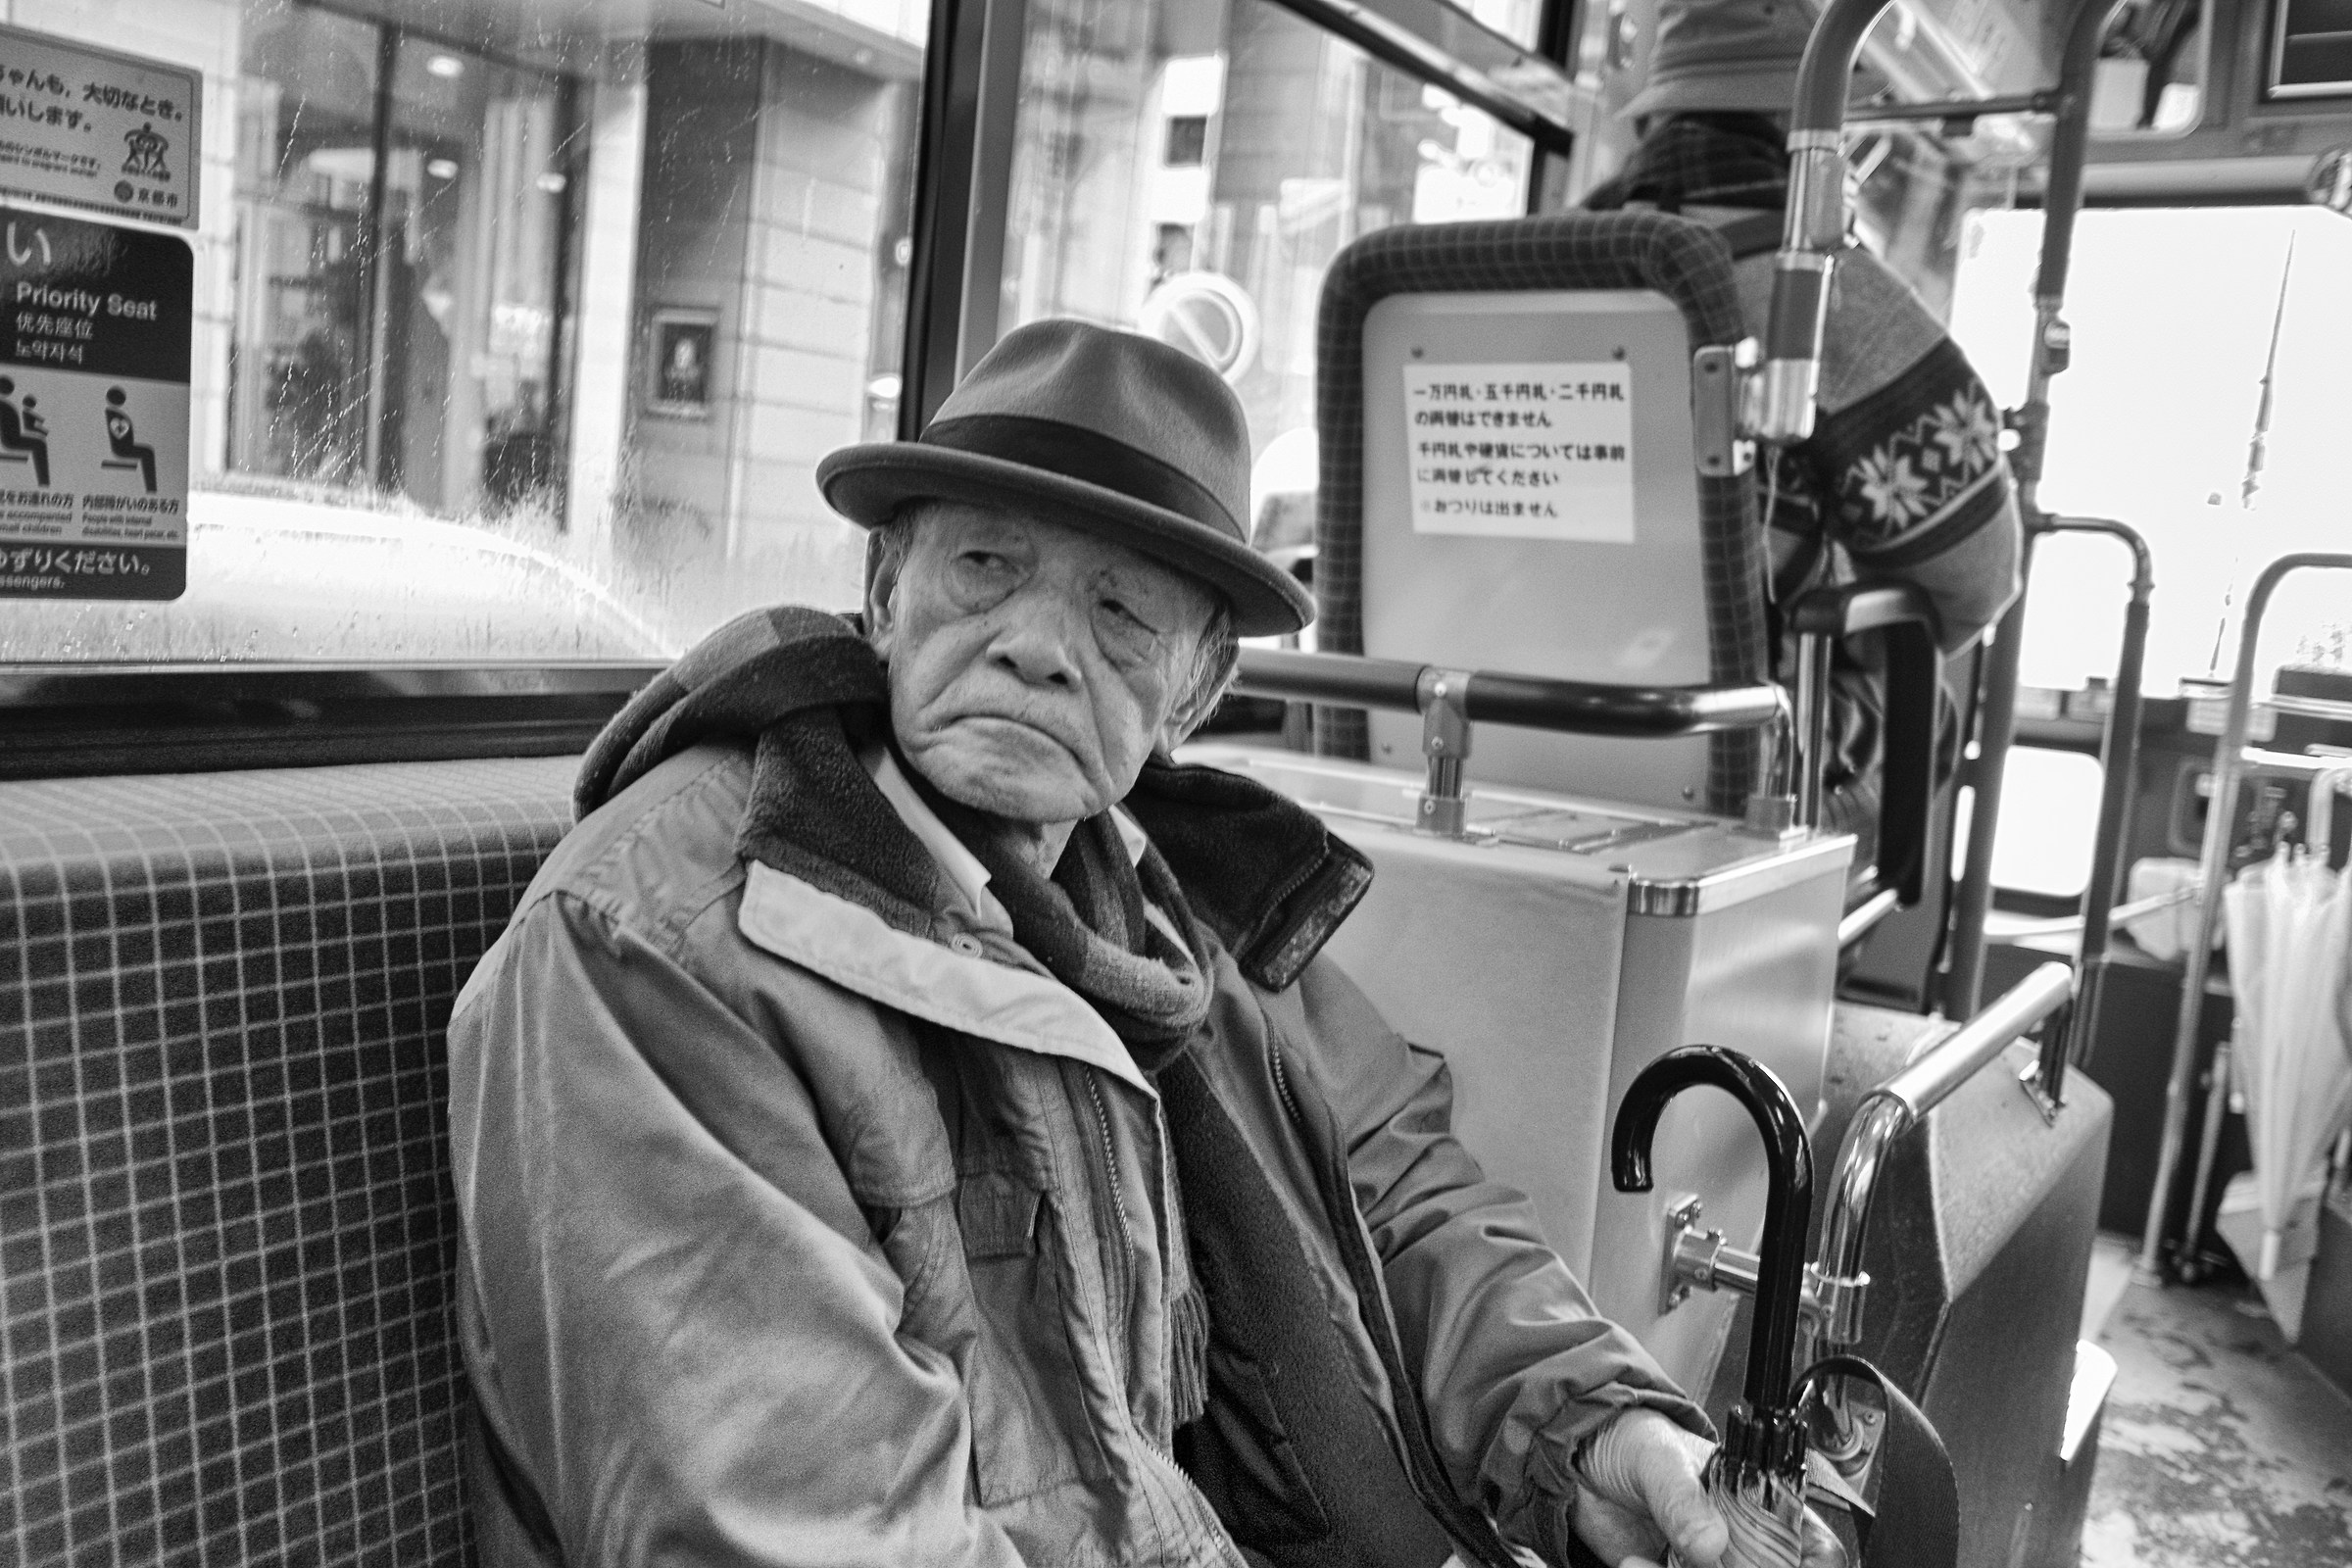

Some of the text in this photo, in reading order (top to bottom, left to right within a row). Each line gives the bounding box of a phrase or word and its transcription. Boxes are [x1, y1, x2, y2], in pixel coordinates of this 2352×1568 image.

[0, 64, 183, 122] ゃんも，大切なとき。
[0, 94, 92, 133] いします。
[17, 281, 157, 320] Priority Seat
[16, 312, 93, 339] 优先座位
[16, 339, 83, 365] 노약자석
